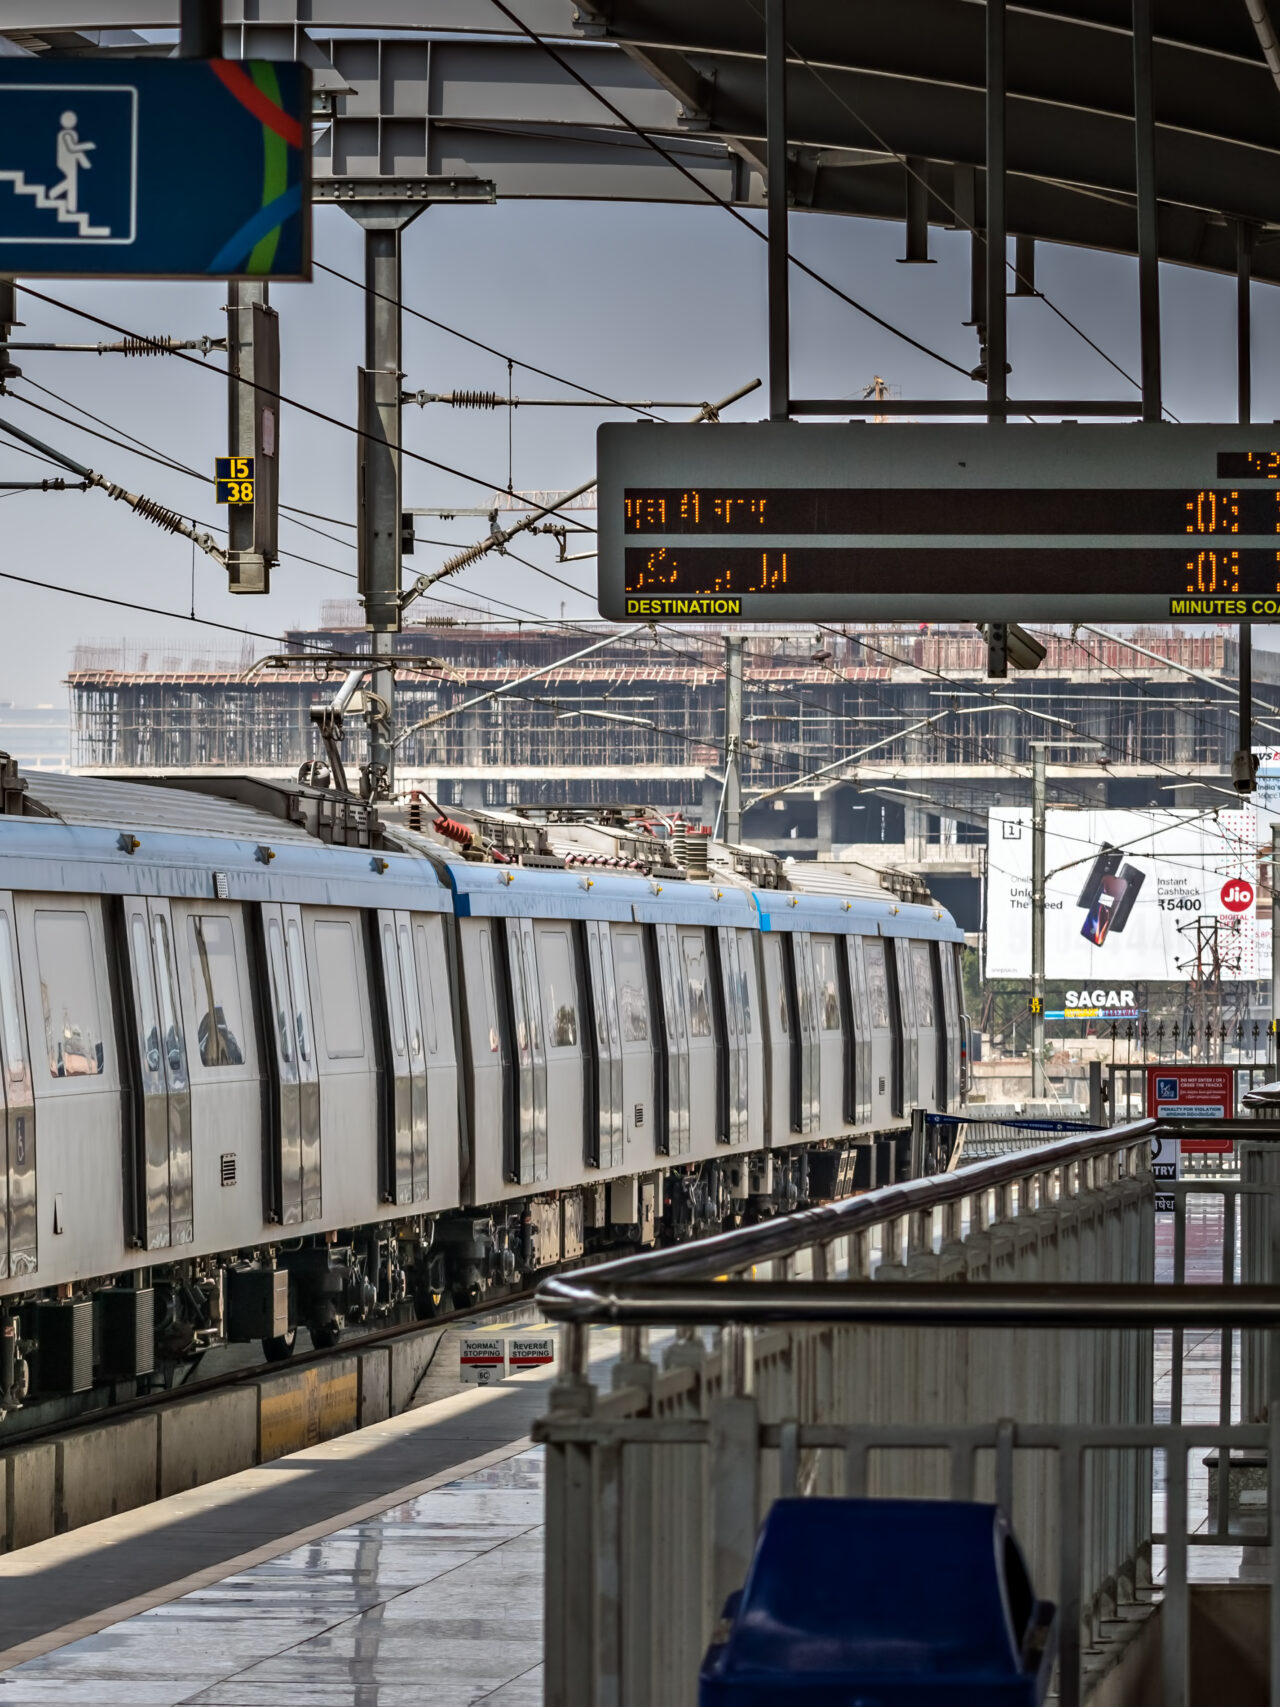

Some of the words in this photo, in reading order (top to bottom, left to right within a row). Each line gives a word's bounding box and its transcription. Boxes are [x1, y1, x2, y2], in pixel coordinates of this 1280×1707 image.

[230, 459, 249, 478] 15
[227, 482, 253, 502] 38
[627, 600, 740, 614] DESTINATION
[1171, 600, 1247, 614] MINUTES
[1157, 887, 1200, 896] Cashback
[1224, 887, 1251, 902] Jio
[1010, 899, 1029, 909] The
[1158, 899, 1202, 911] ₹5400
[1065, 990, 1135, 1007] SAGAR
